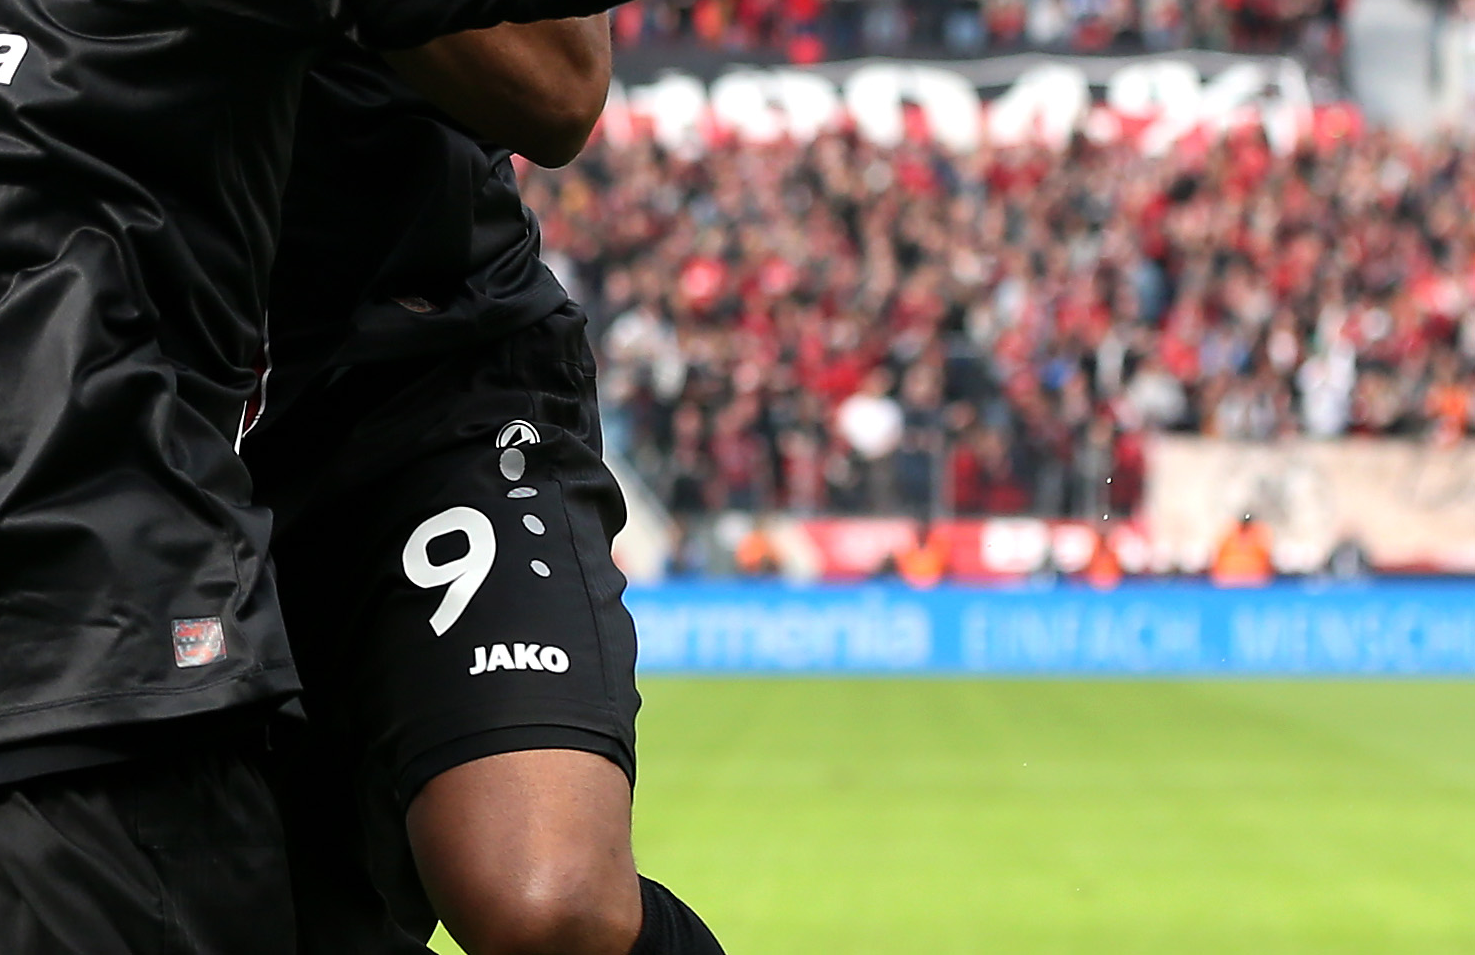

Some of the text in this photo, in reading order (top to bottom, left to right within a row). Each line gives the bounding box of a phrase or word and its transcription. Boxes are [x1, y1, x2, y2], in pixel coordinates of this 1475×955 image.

[402, 506, 496, 636] 9
[469, 643, 570, 675] JAKO
[636, 590, 929, 668] armenia
